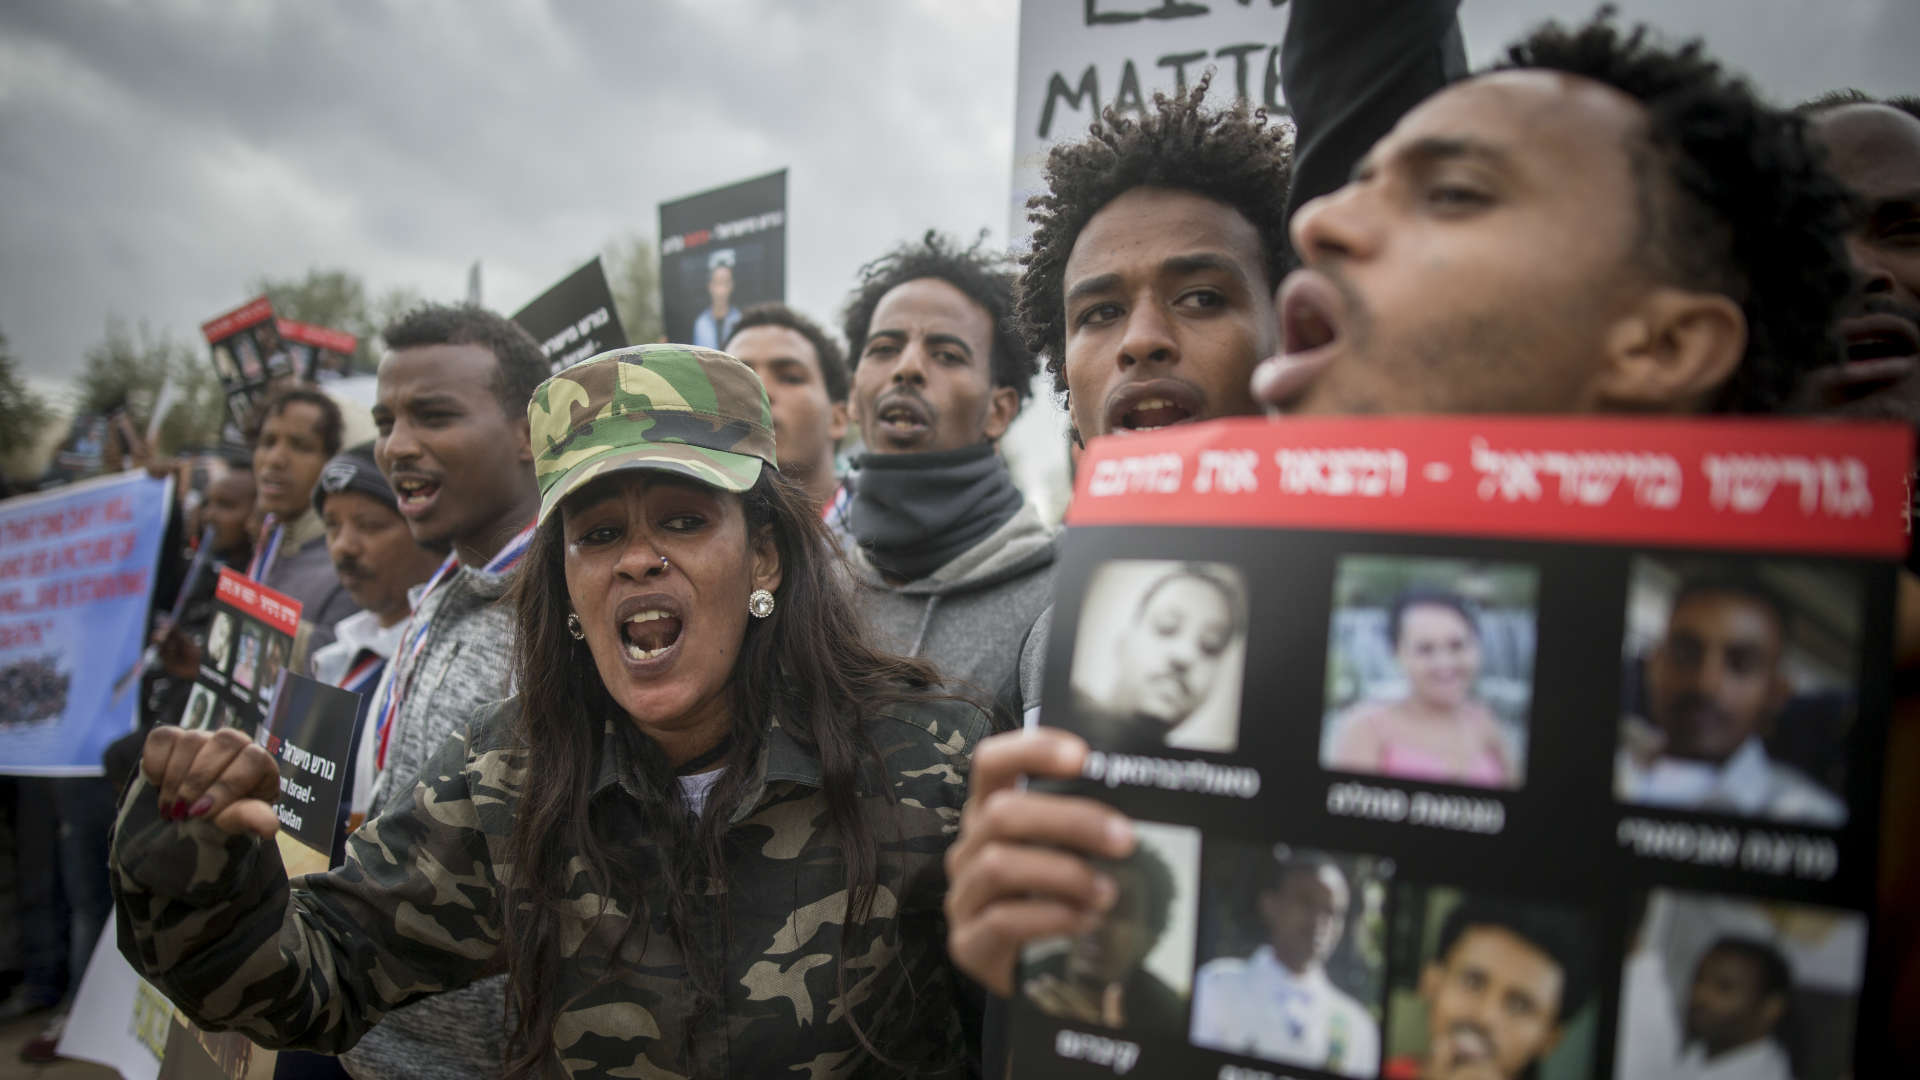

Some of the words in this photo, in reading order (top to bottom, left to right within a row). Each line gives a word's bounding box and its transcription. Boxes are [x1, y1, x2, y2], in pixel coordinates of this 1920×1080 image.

[1037, 43, 1290, 139] MATTE
[1089, 452, 1183, 496] מותם
[1193, 449, 1259, 494] את
[1275, 448, 1408, 497] ומצאו
[1470, 435, 1682, 510] מישראל
[1703, 452, 1873, 518] גורשו
[310, 754, 336, 781] גורש
[287, 778, 312, 803] Israel
[279, 803, 302, 831] Sudan
